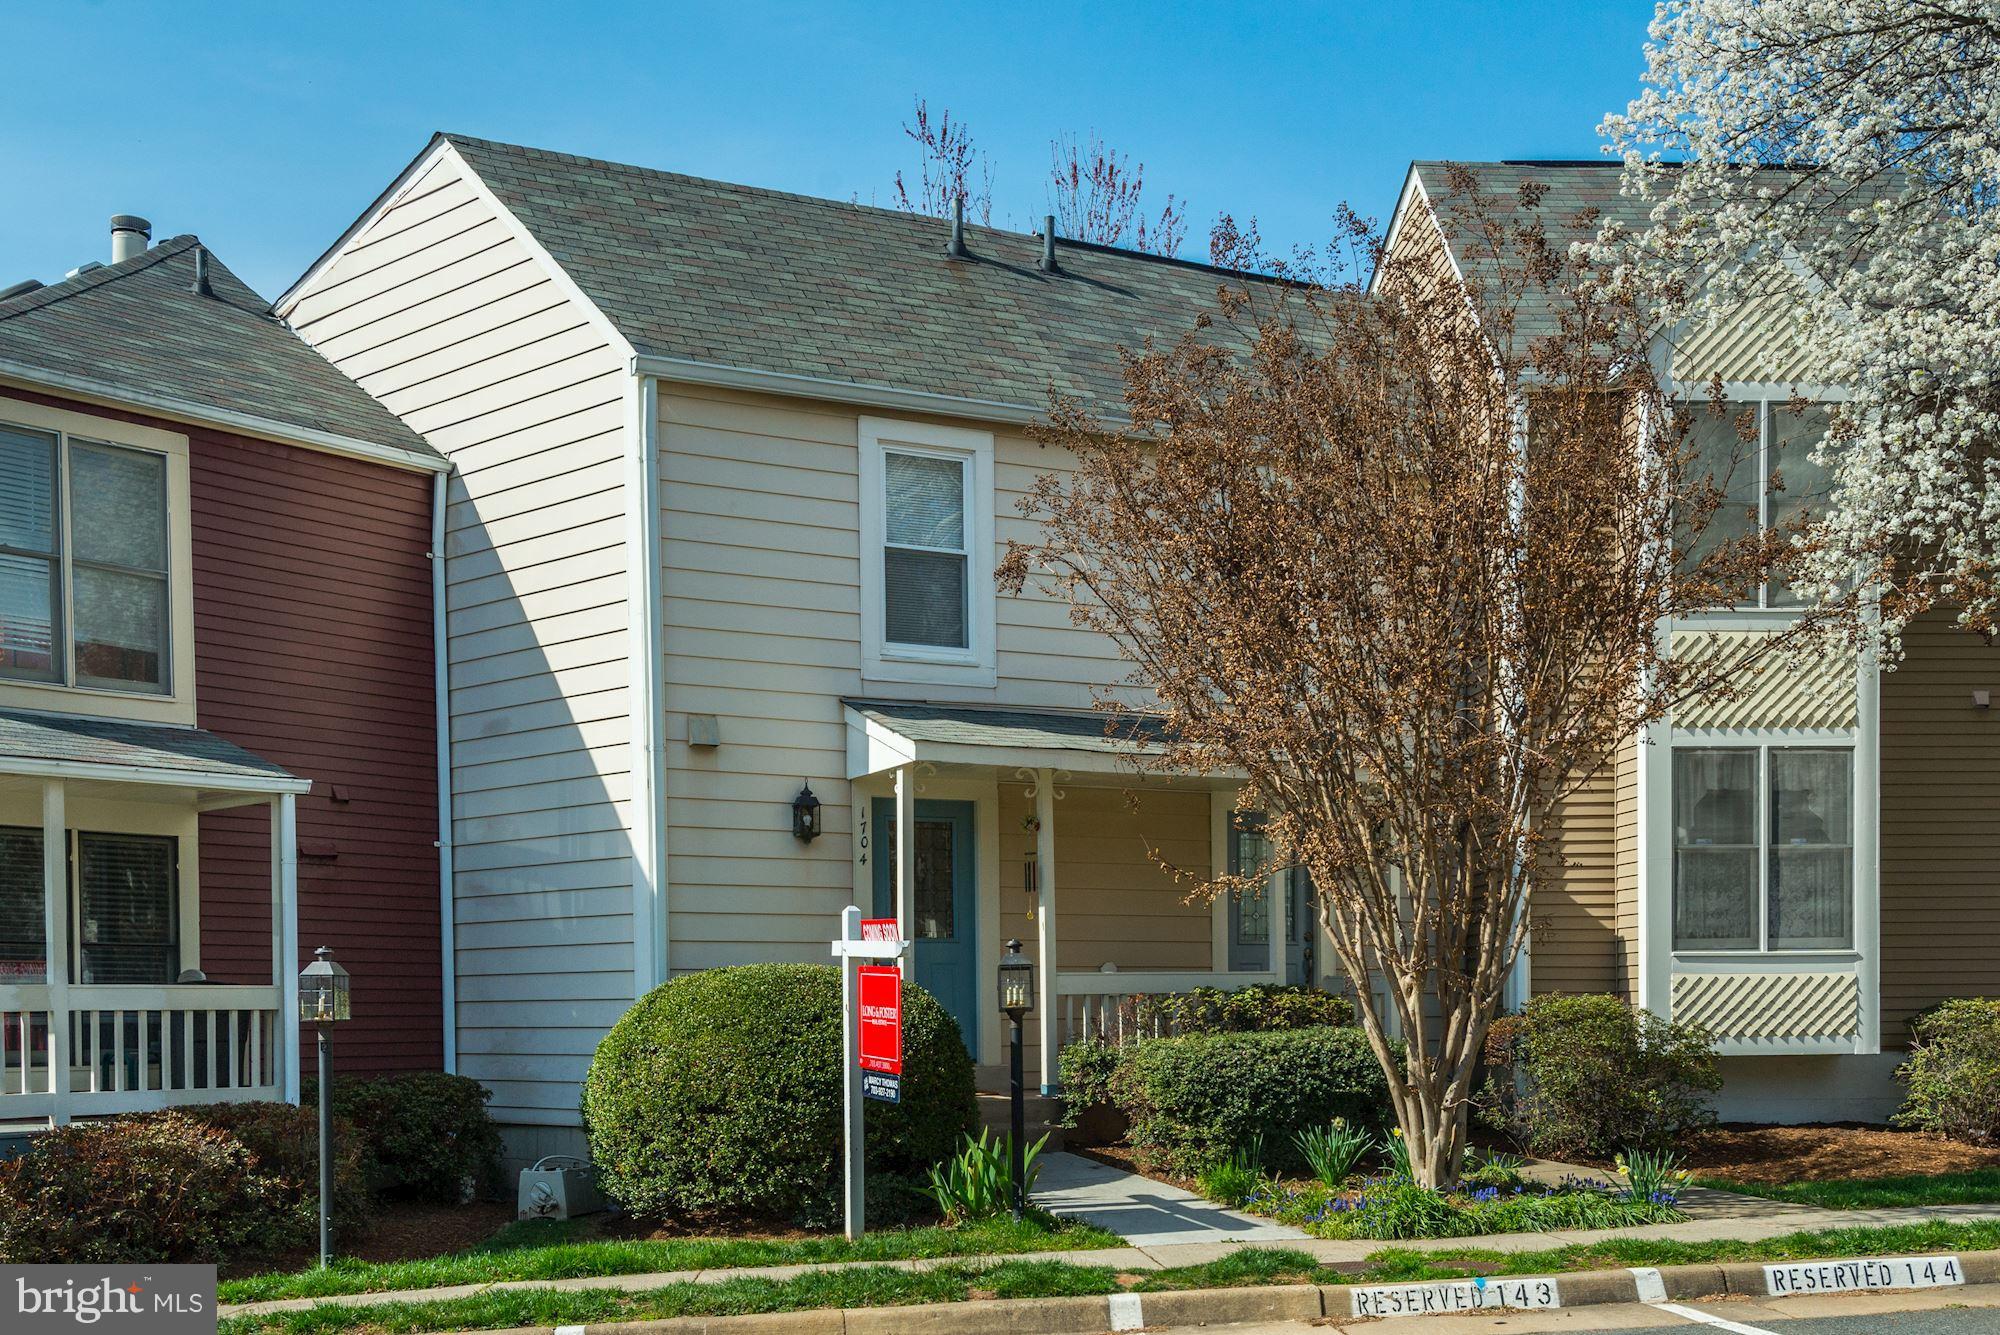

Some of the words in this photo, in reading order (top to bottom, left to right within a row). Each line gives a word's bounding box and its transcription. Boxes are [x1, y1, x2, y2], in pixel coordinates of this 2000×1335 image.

[860, 806, 868, 866] 1704
[1773, 1264, 1892, 1291] RESERVED
[1906, 1260, 1957, 1285] 144
[1357, 1282, 1484, 1315] RESERVED
[1496, 1282, 1551, 1307] 143
